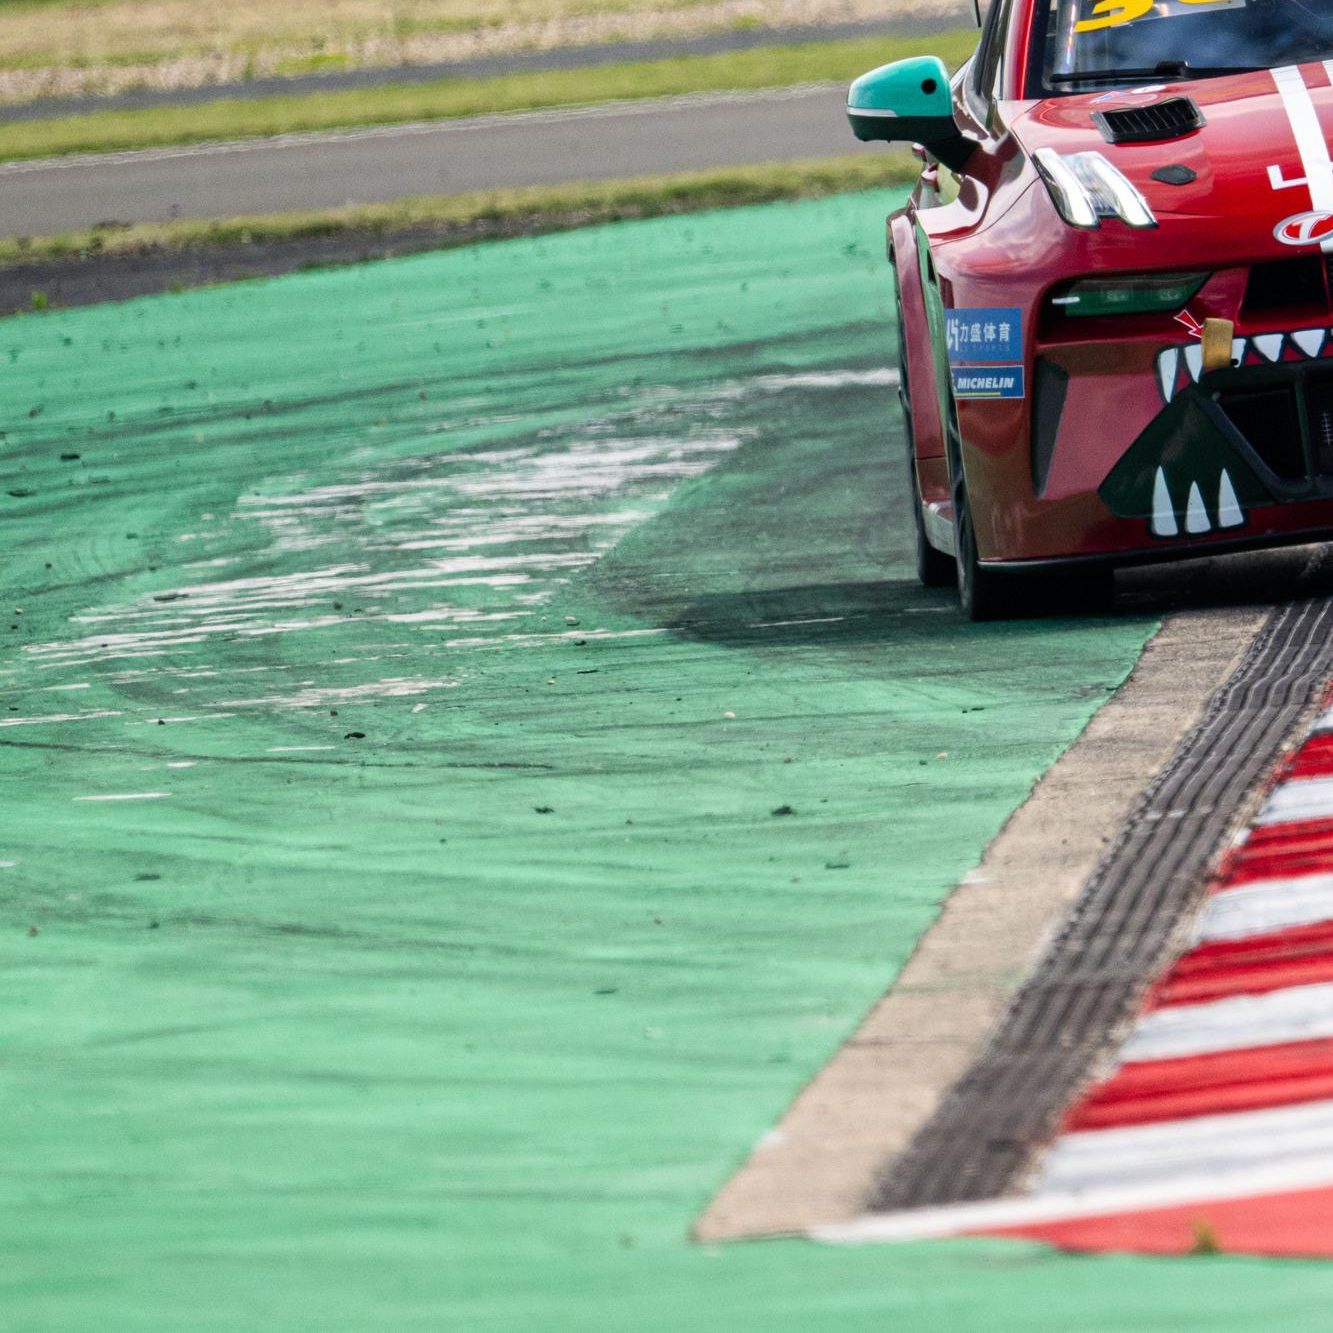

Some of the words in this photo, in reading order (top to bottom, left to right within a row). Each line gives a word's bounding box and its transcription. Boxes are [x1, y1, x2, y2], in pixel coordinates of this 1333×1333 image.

[960, 321, 1011, 343] 力盛体育
[957, 377, 1015, 390] MICHELIN
